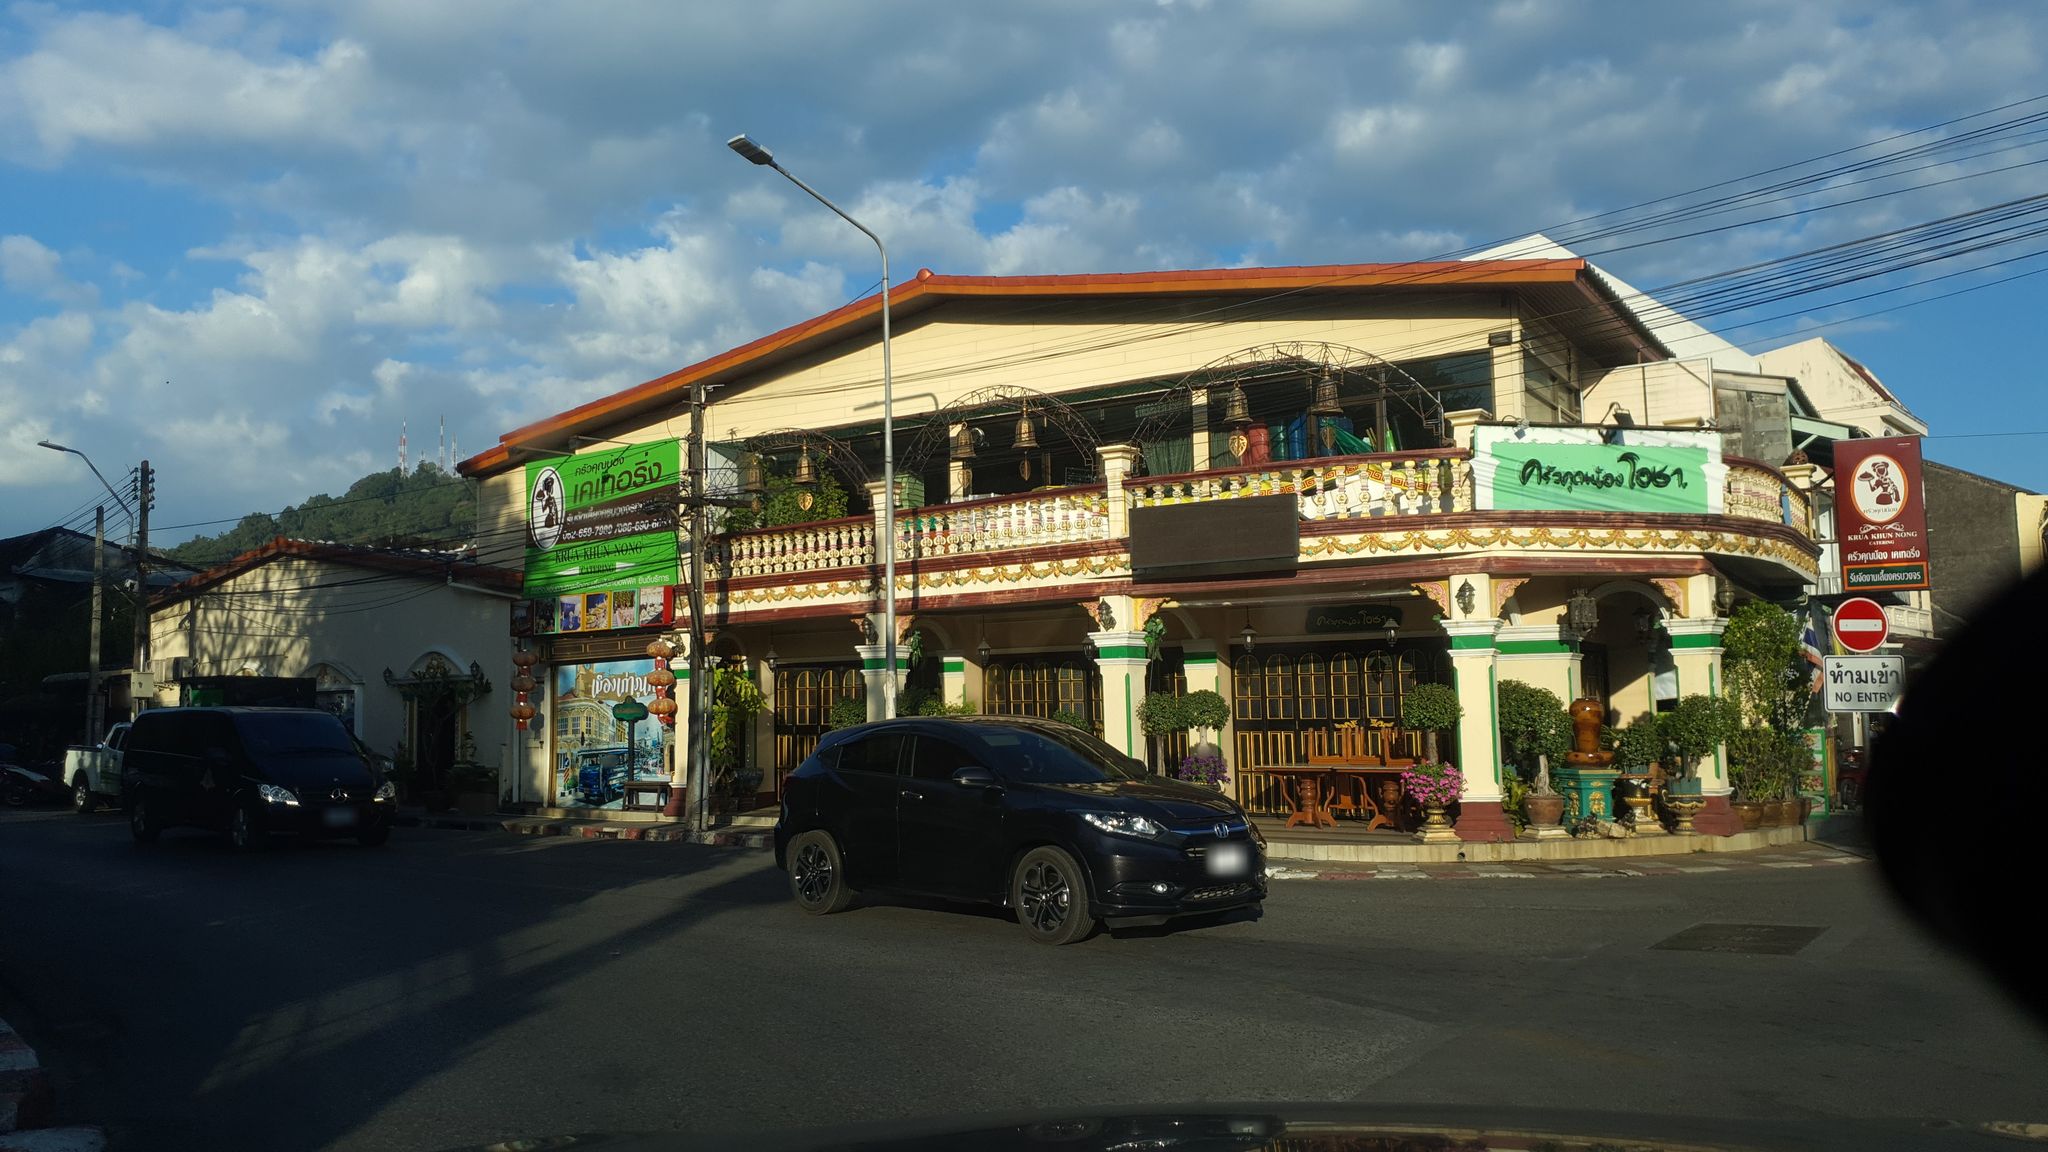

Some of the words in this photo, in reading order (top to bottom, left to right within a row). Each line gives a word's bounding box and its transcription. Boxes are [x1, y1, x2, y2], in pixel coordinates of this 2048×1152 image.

[1847, 534, 1870, 542] KRUA
[1871, 532, 1894, 540] KHUN
[613, 541, 643, 558] NONG
[1829, 661, 1901, 685] ห้ามเข้า
[1835, 691, 1853, 703] NO
[1857, 691, 1895, 703] ENTRY
